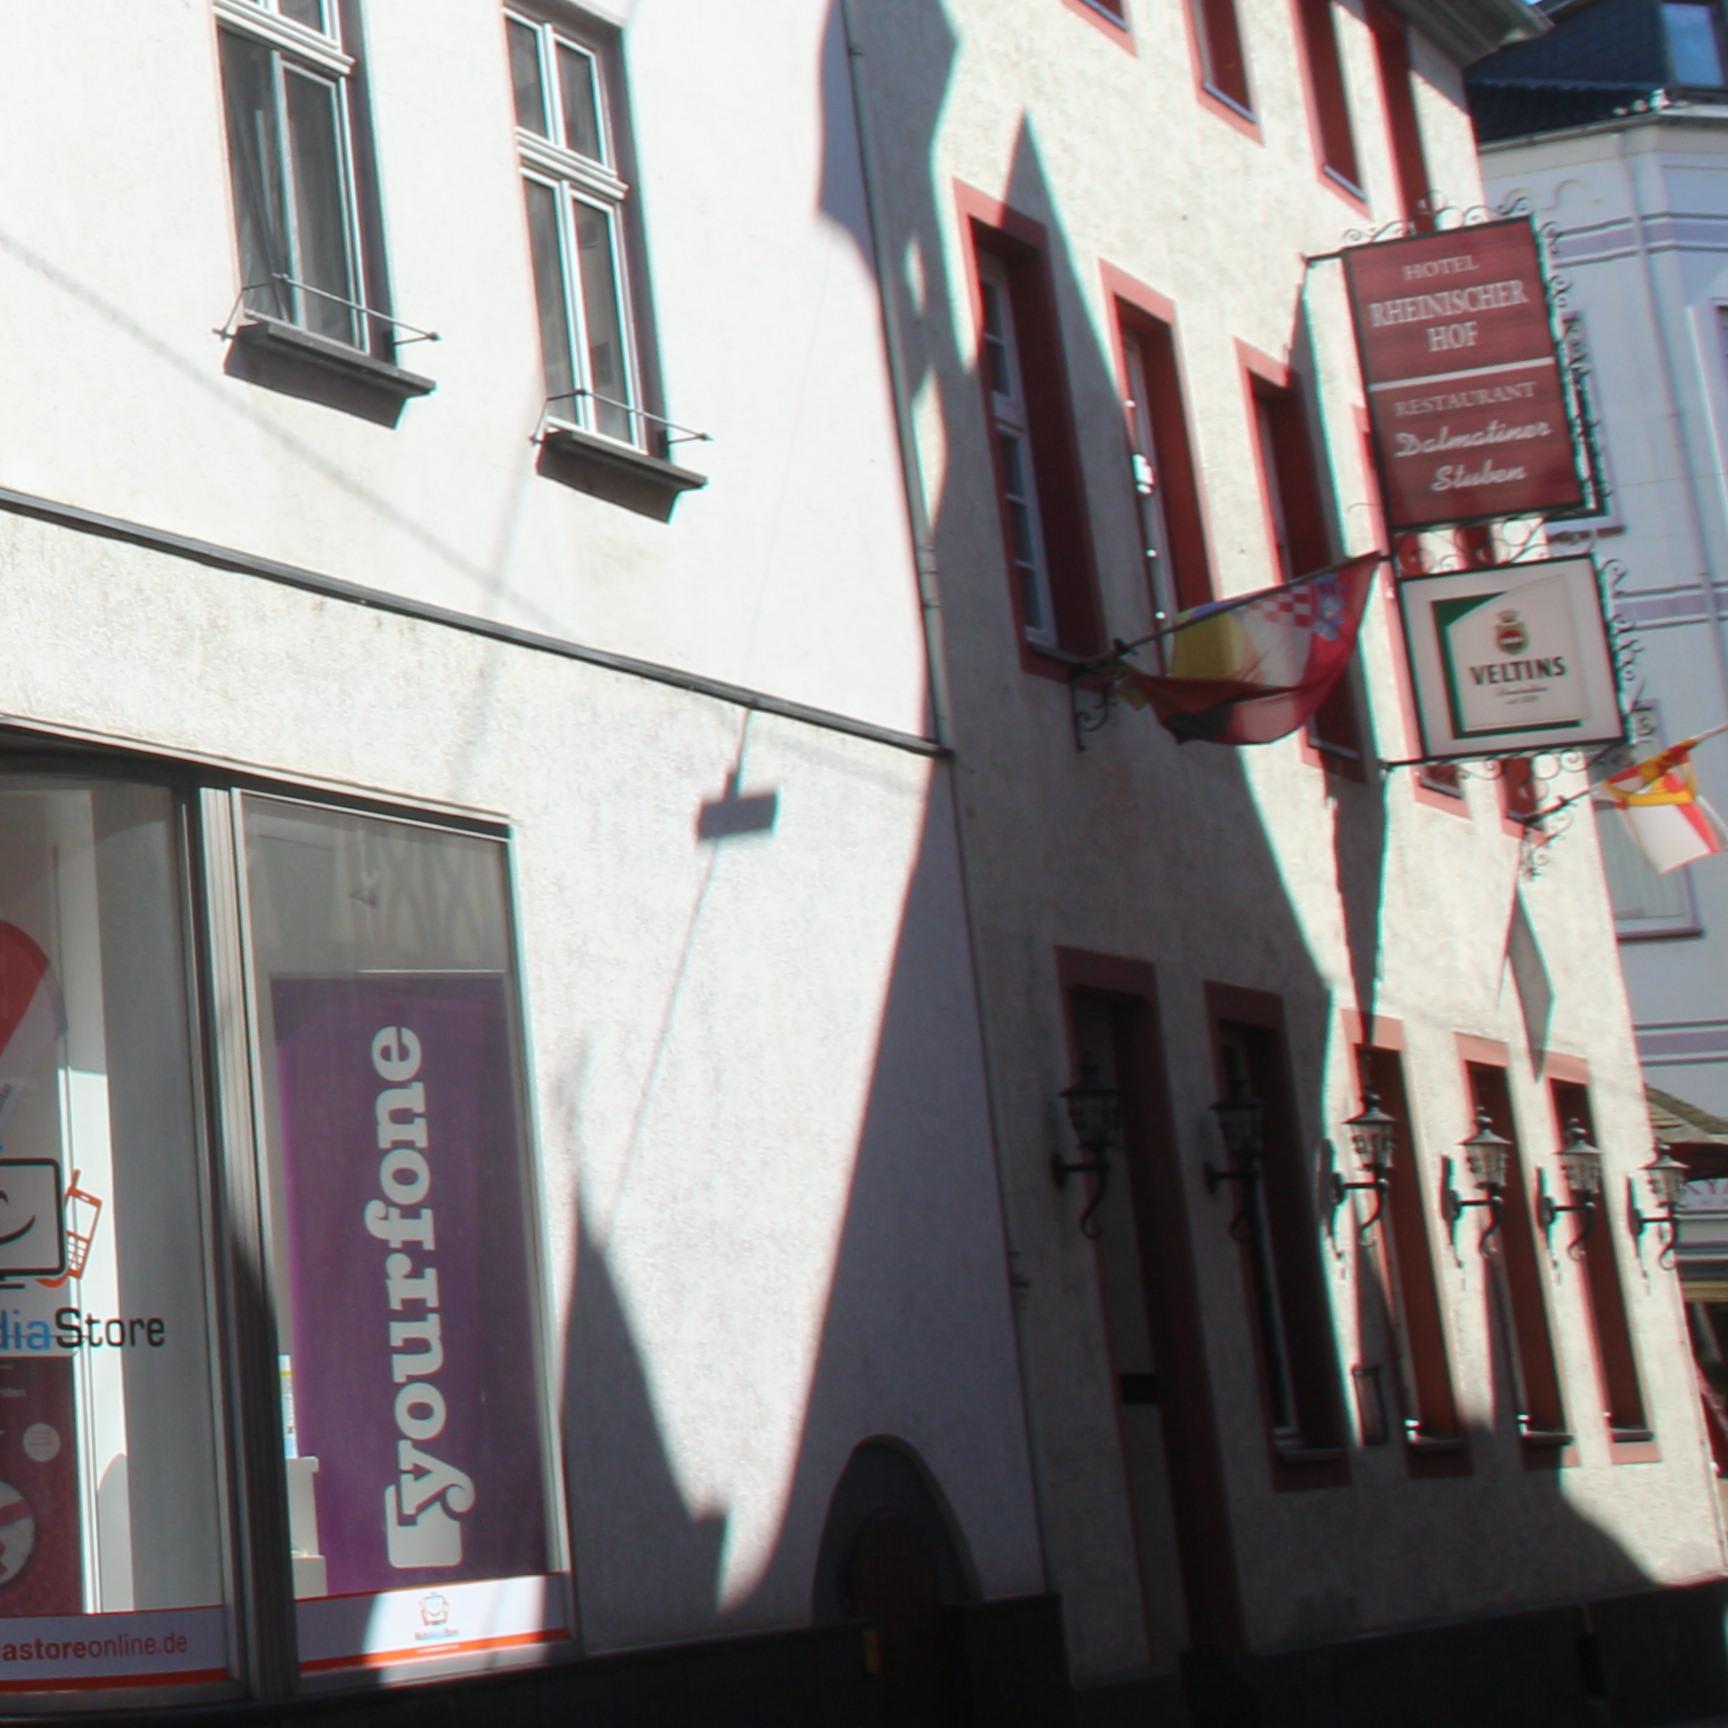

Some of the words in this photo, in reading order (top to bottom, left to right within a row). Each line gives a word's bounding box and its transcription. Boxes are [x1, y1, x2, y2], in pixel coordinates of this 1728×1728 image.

[1402, 255, 1480, 280] HOTEL
[1369, 279, 1529, 328] RHEINISCHER
[1425, 321, 1480, 352] HOF
[1394, 381, 1537, 417] RESTAURANT
[1394, 419, 1551, 457] Dalmatiner
[1431, 459, 1527, 491] Stuben
[1470, 656, 1566, 685] VELTINS
[364, 1025, 476, 1517] yourfone
